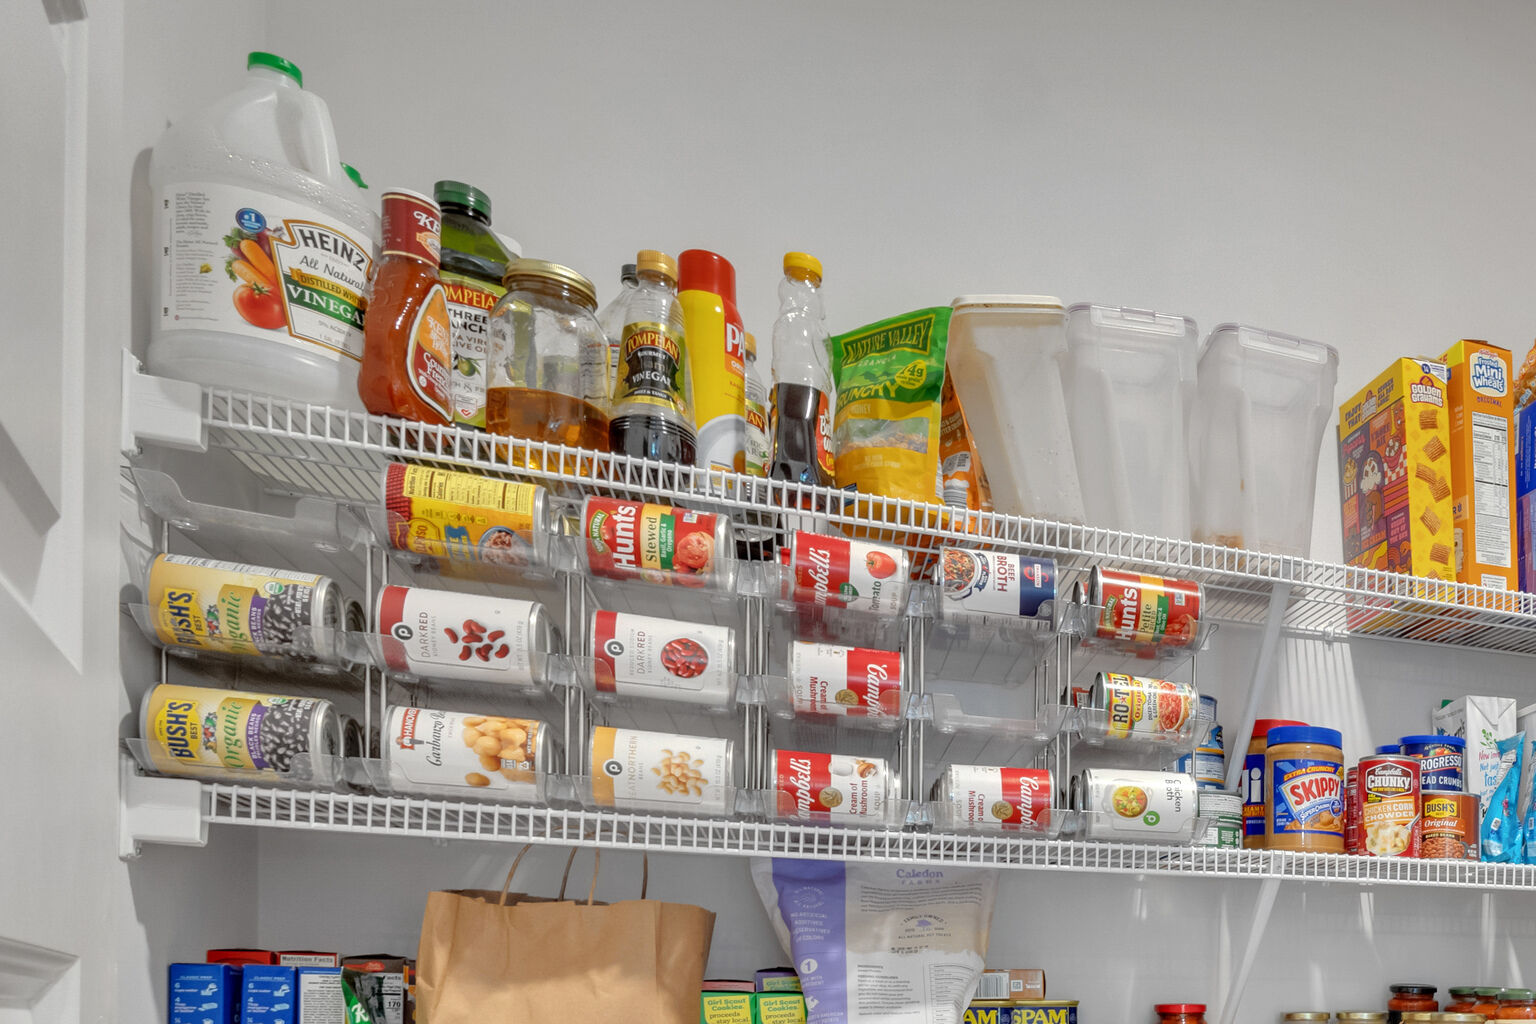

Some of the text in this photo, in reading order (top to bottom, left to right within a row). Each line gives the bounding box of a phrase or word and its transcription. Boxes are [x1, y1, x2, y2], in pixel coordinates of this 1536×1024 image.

[297, 228, 367, 272] HEINZ
[299, 254, 365, 292] All Natural
[300, 274, 341, 298] DISTILLED
[286, 284, 366, 327] VINEGA
[628, 331, 680, 363] POMPEIAN
[848, 319, 930, 364] NATURE VALLEY
[1472, 374, 1505, 392] Wheats
[1474, 363, 1503, 380] Mini
[607, 505, 637, 569] Hunt's
[645, 517, 658, 563] Stewed
[997, 555, 1008, 593] BROTH
[1007, 564, 1015, 582] BEEF
[1114, 587, 1138, 641] Hunt's
[166, 702, 195, 760] BUSH'S
[222, 700, 248, 768] Organic
[1290, 776, 1340, 806] SKIPPY
[1368, 775, 1411, 789] CHUNKY
[1365, 811, 1415, 821] CHOWDER
[1393, 802, 1414, 812] CORN
[1426, 803, 1455, 814] BUSH'S
[1424, 818, 1457, 828] Original
[896, 868, 945, 880] Caledon
[707, 998, 746, 1008] Girl Scout
[709, 1011, 740, 1021] proceeds
